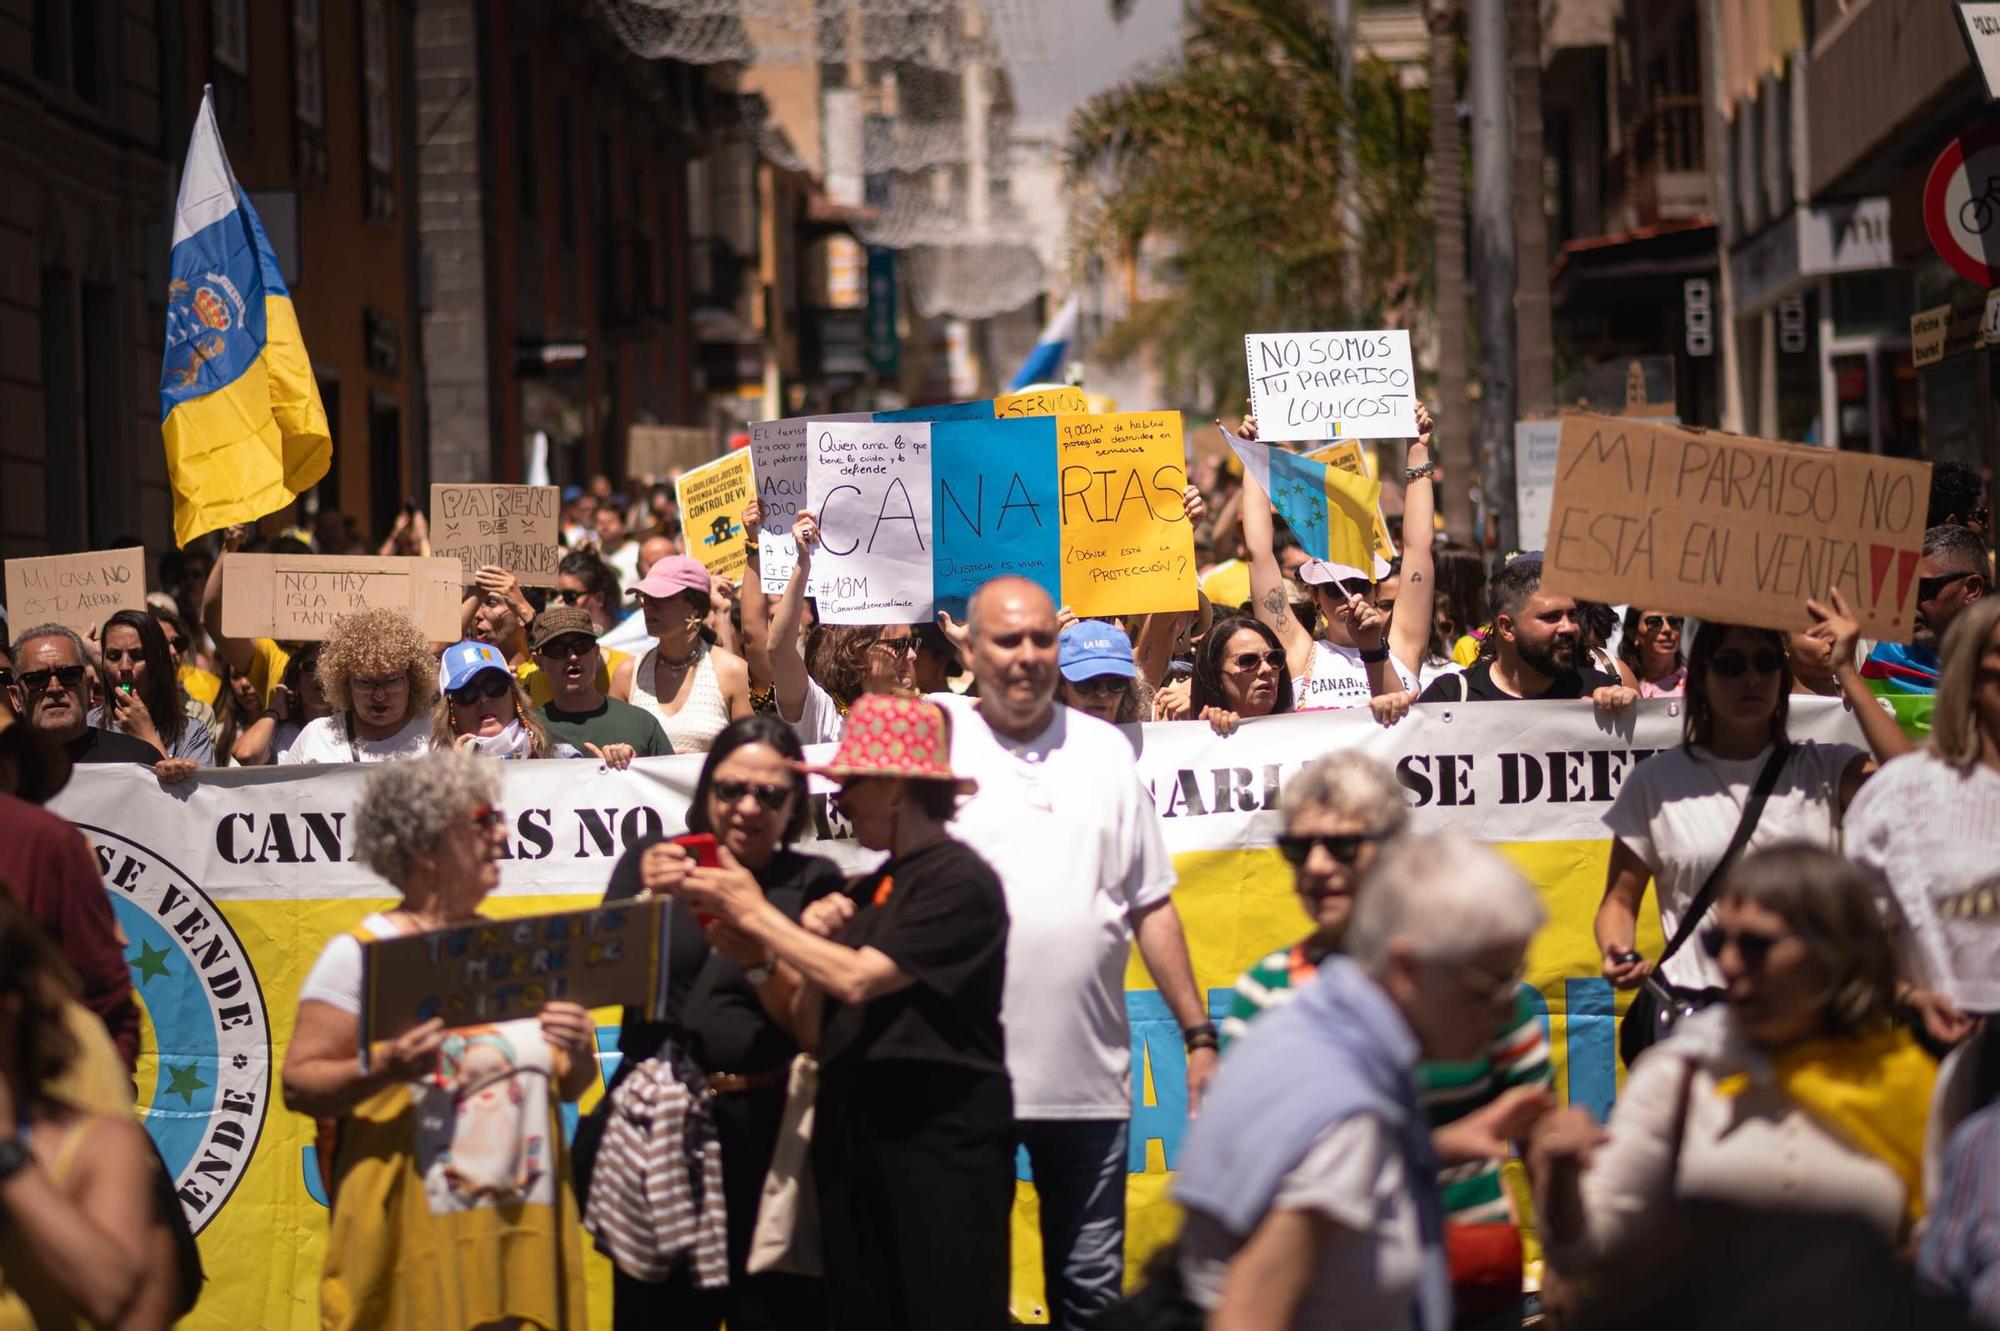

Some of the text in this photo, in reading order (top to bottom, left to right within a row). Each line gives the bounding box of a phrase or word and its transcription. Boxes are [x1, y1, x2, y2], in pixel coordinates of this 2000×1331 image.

[1260, 336, 1392, 372] NO SOMOS
[1256, 367, 1409, 396] TU PARAISO
[1287, 394, 1409, 427] LOWCOST
[1114, 423, 1124, 432] de
[819, 431, 928, 455] Quien ama lo que
[1063, 437, 1103, 452] protegido
[1095, 446, 1145, 457] semanas
[819, 454, 845, 465] tiene
[839, 463, 888, 477] defiende
[1563, 430, 1915, 534] MI PARAISO NO
[441, 486, 553, 518] PAREN
[689, 495, 724, 520] CONTROL
[725, 491, 735, 505] DE
[479, 518, 508, 536] DE
[1553, 507, 1662, 581] ESTÁ
[1678, 522, 1731, 586] EN
[22, 564, 131, 589] MI CASA NO
[284, 572, 369, 592] NO HAY
[819, 575, 869, 599] #18M
[286, 592, 327, 608] ISLA
[1311, 676, 1371, 694] CANARIAS
[178, 1087, 256, 1217] ENDE
